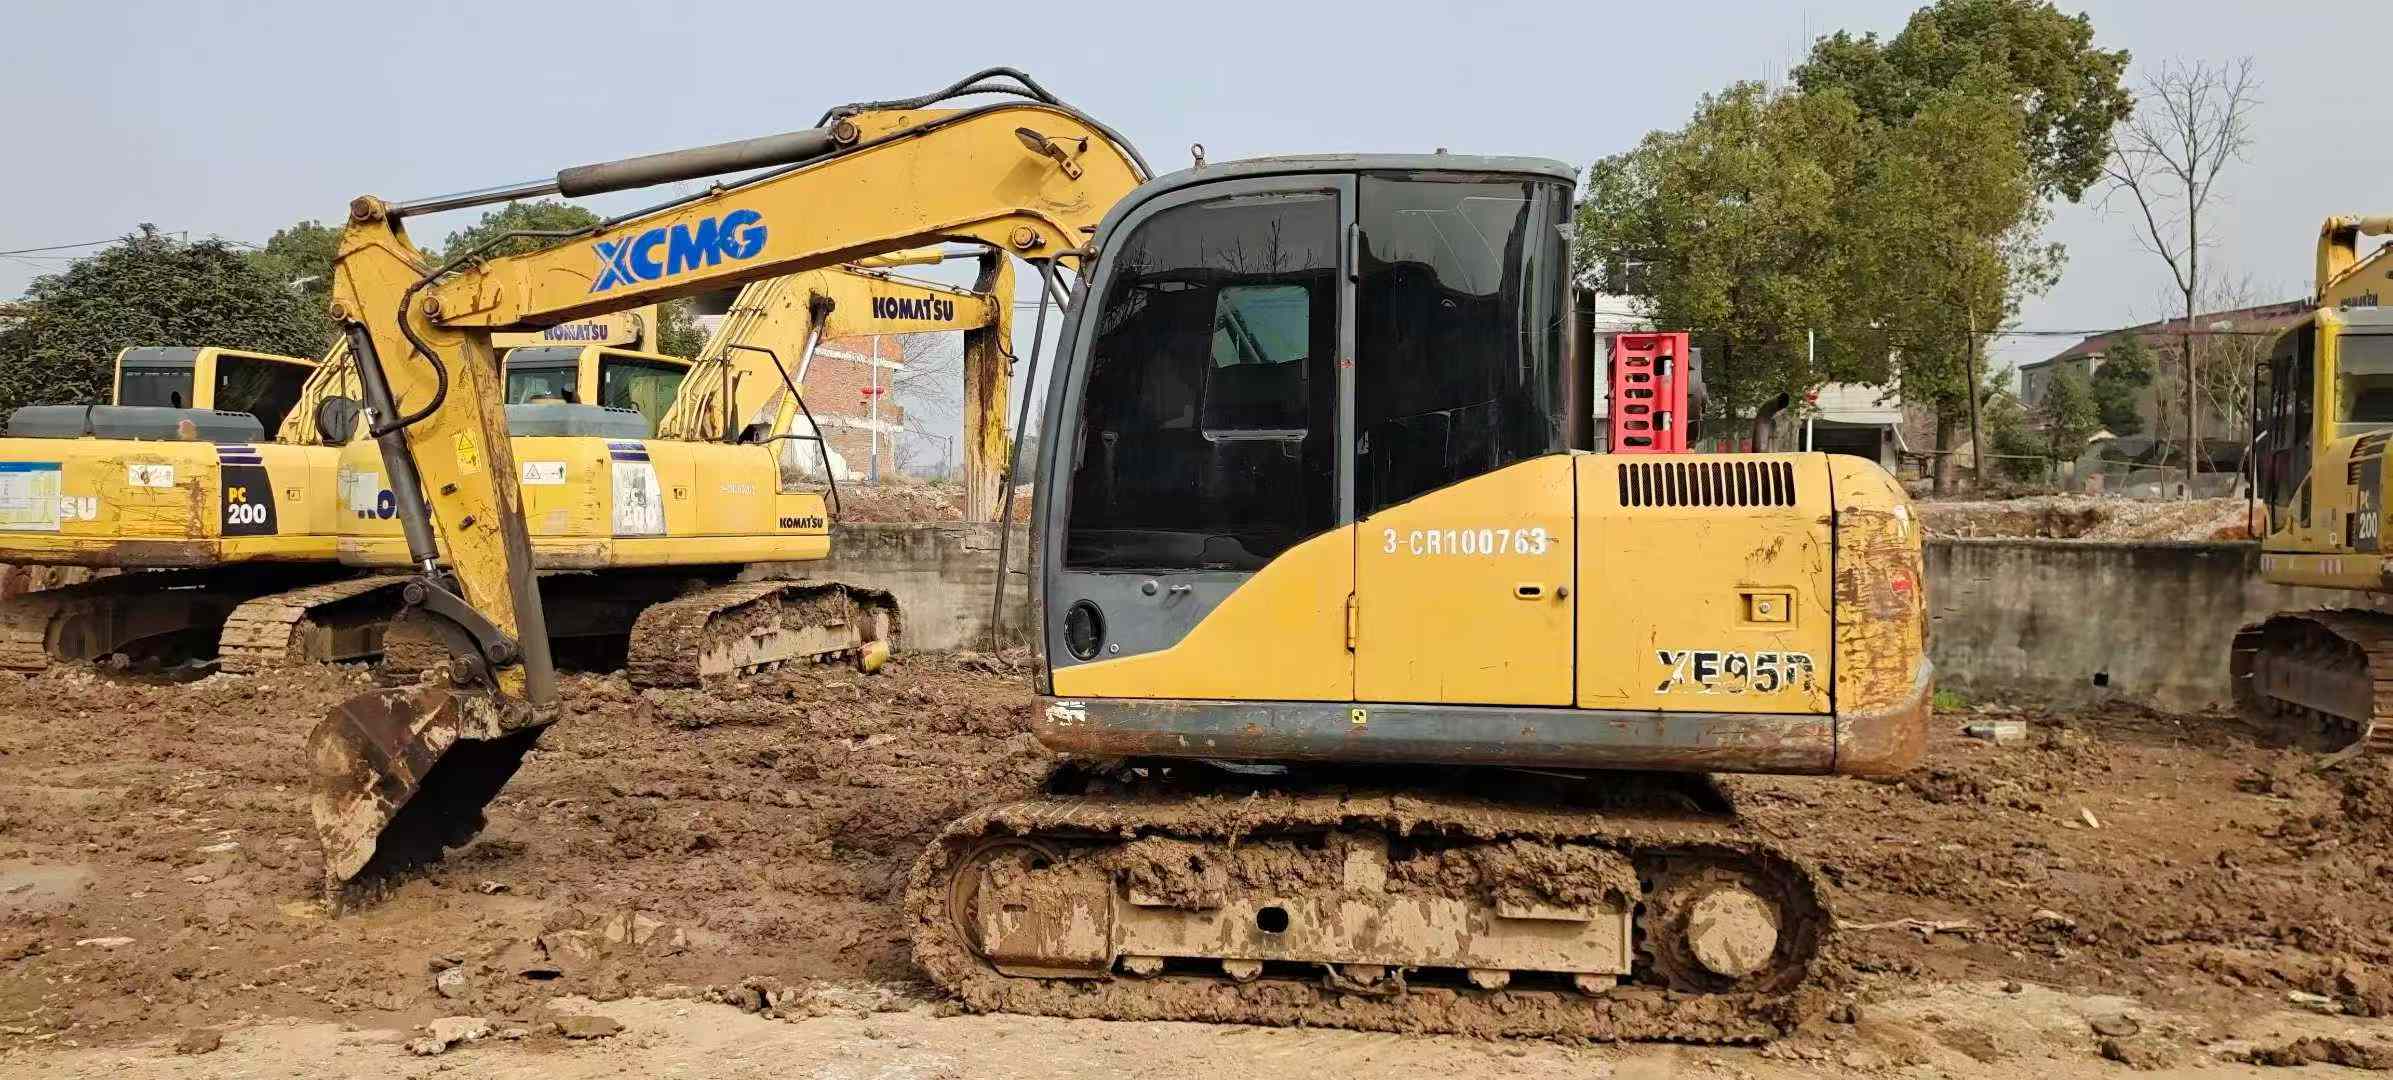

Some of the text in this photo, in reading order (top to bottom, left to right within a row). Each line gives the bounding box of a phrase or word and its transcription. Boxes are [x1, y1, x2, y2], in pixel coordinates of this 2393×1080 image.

[588, 208, 768, 293] XCMG
[872, 294, 954, 322] KOMATSU
[228, 487, 247, 503] PC
[228, 503, 267, 524] 200
[779, 514, 823, 528] KOMATSU
[2359, 512, 2378, 539] 200
[1383, 527, 1547, 556] 3-CR100763
